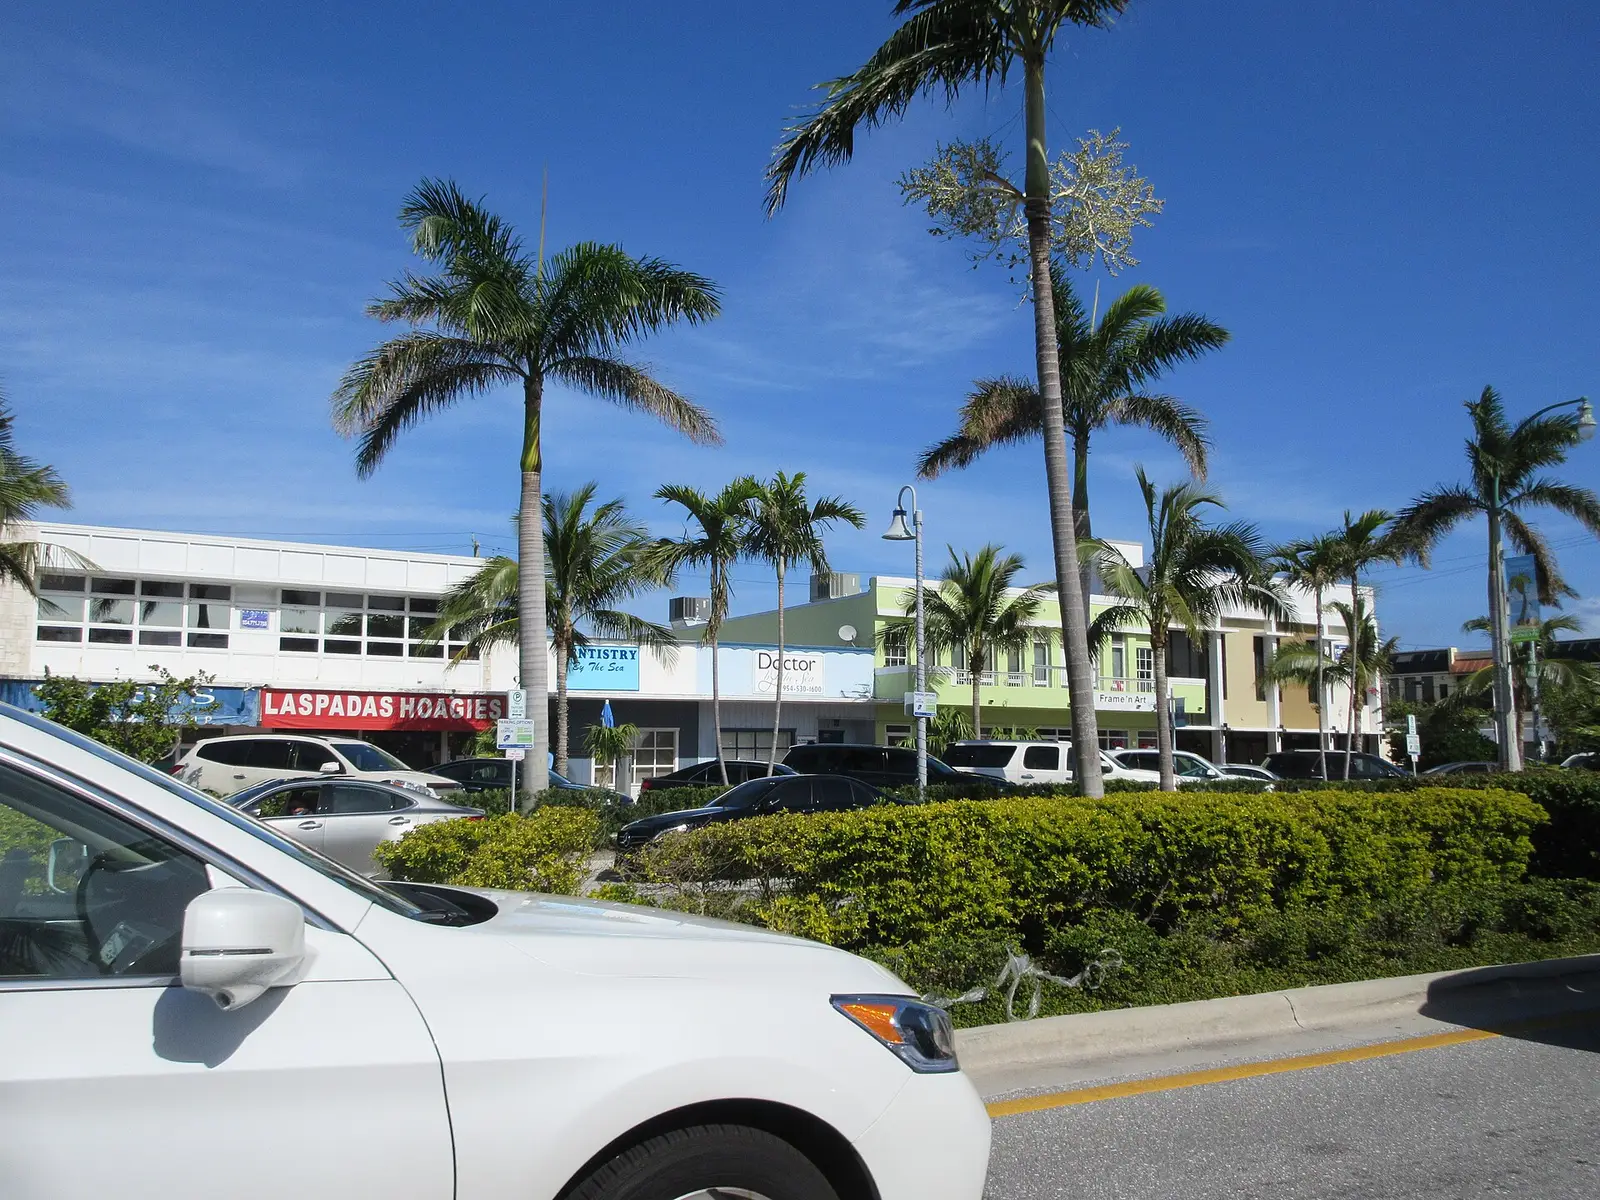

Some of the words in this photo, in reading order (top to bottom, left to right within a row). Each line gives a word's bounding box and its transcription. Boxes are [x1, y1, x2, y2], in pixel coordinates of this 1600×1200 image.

[578, 648, 637, 660] NTISTRY
[589, 662, 605, 671] The
[608, 662, 624, 672] Sea
[758, 652, 816, 671] Doctor
[1134, 695, 1146, 704] Art
[264, 692, 394, 717] LASPADAS
[400, 697, 502, 720] HOAGIES
